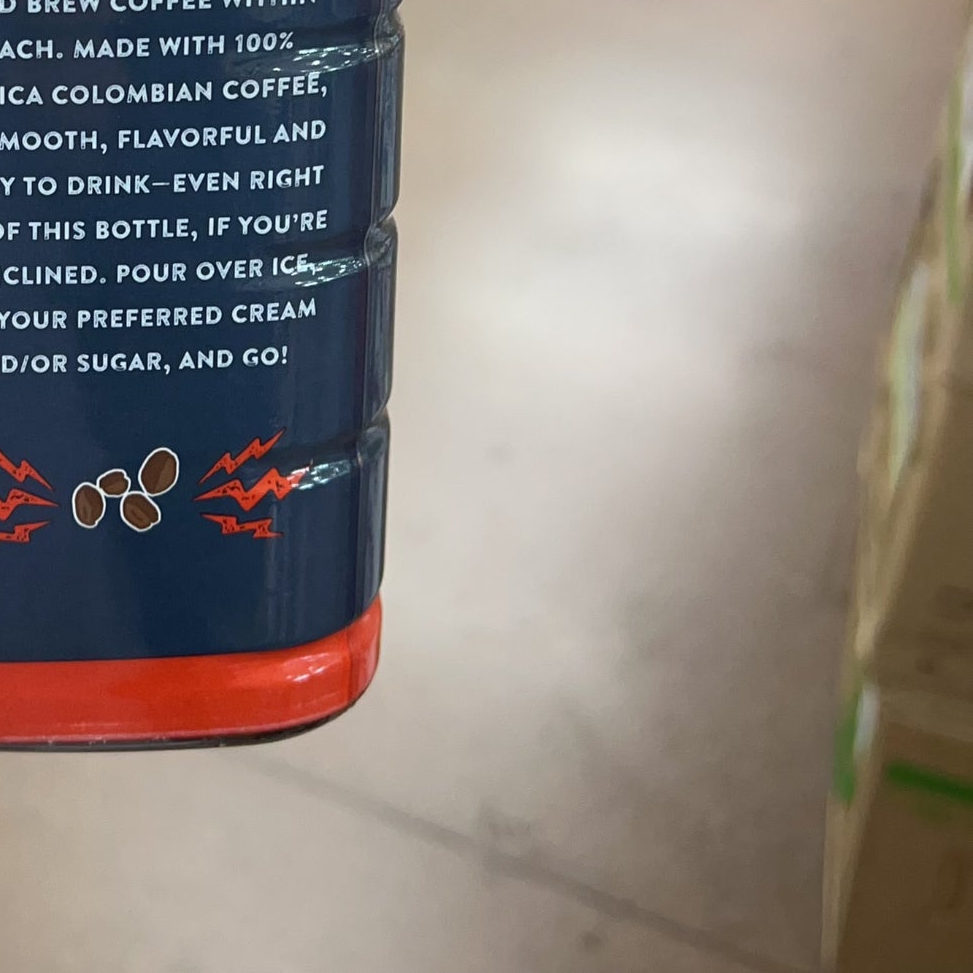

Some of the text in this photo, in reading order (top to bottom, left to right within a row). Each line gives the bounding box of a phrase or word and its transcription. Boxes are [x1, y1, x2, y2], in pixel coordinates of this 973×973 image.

[73, 37, 150, 59] MADE
[158, 35, 225, 57] WITH
[235, 31, 294, 53] 100%
[52, 81, 212, 105] COLOMBIAN
[222, 72, 327, 100] COFFEE,
[118, 125, 267, 149] FLAVORFUL
[273, 119, 326, 143] AND
[23, 176, 57, 196] TO
[250, 164, 324, 190] RIGHT
[29, 221, 85, 241] THIS
[96, 218, 198, 242] BOTTLE,
[208, 216, 231, 236] IF
[238, 209, 327, 235] YOU'RE
[116, 262, 187, 283] POUR
[196, 258, 264, 281] OVER
[77, 306, 222, 329] PREFERRED
[231, 297, 316, 324] CREAM
[77, 352, 171, 375] SUGAR,
[178, 349, 234, 370] AND
[242, 345, 288, 367] GO!
